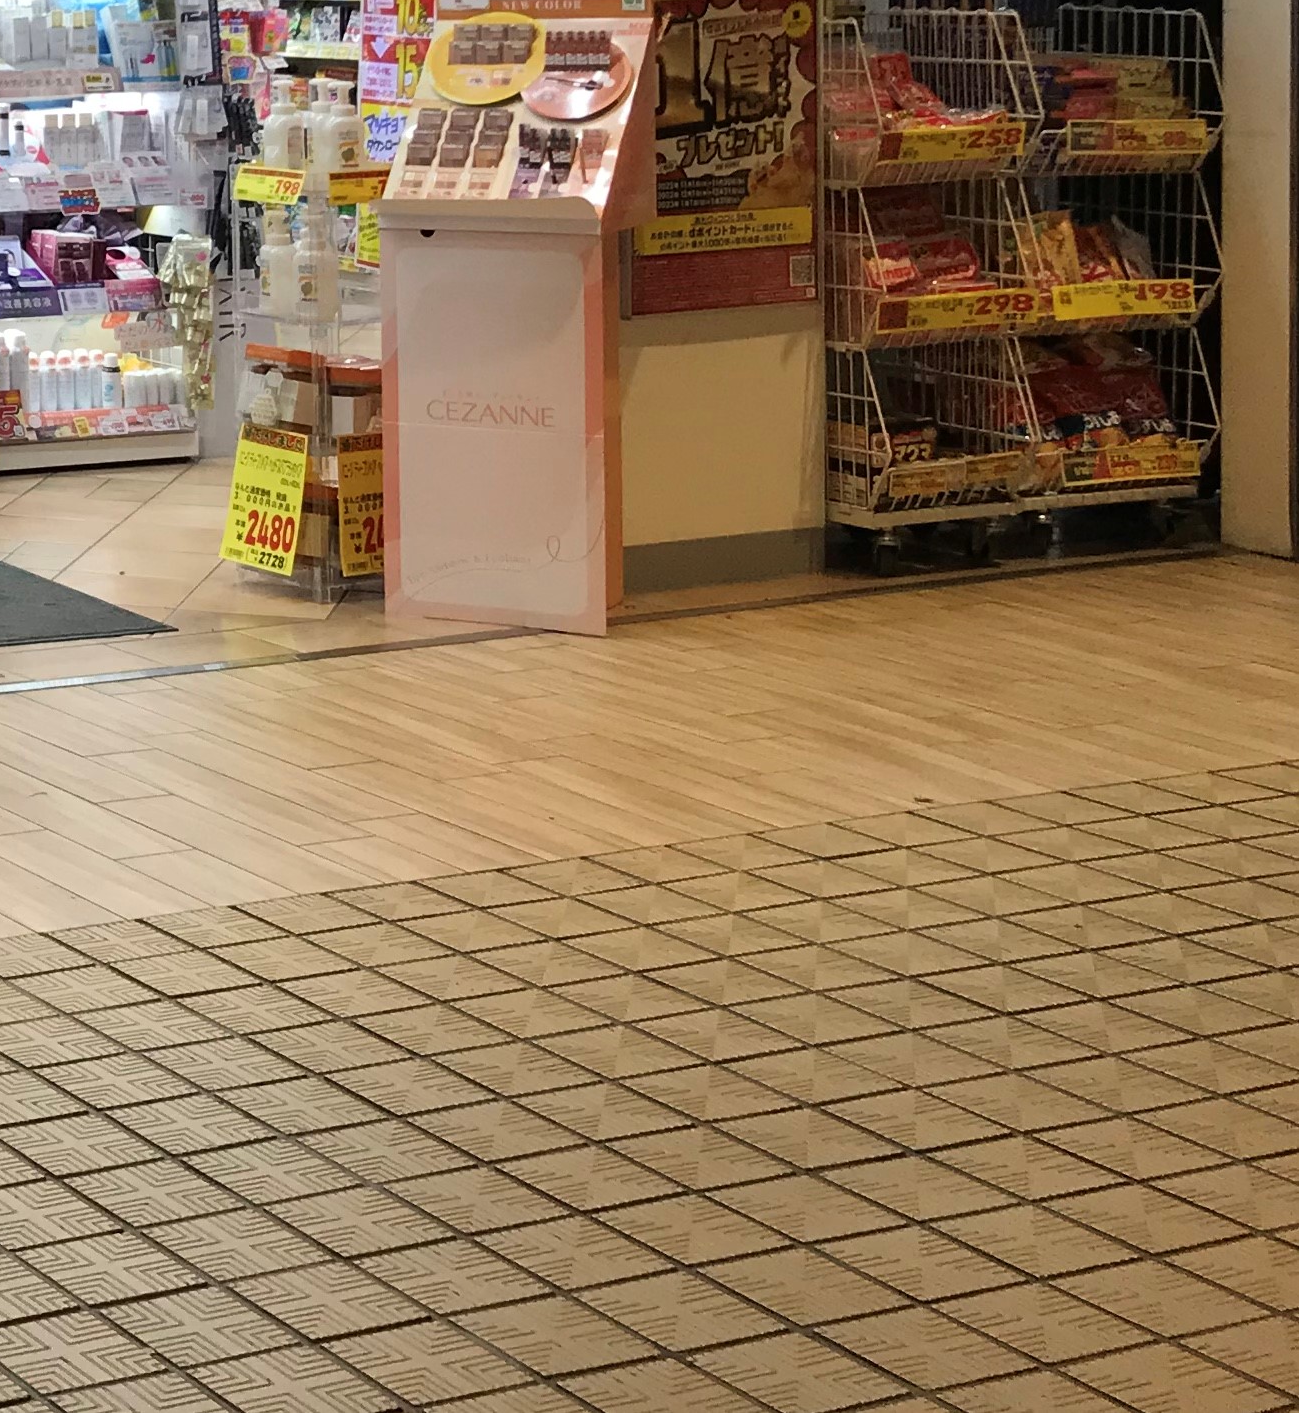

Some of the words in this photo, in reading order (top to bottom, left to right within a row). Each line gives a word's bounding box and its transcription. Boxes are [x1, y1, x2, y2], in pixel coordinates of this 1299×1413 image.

[502, 0, 529, 11] NEW
[535, 0, 583, 11] COLOR
[676, 120, 785, 168] プレゼント!
[967, 127, 1023, 149] 258
[274, 179, 301, 197] 798
[1134, 282, 1191, 301] 198
[975, 293, 1035, 315] 298
[427, 399, 556, 428] CEZANNE
[244, 509, 296, 553] 2480
[258, 551, 285, 569] 2728
